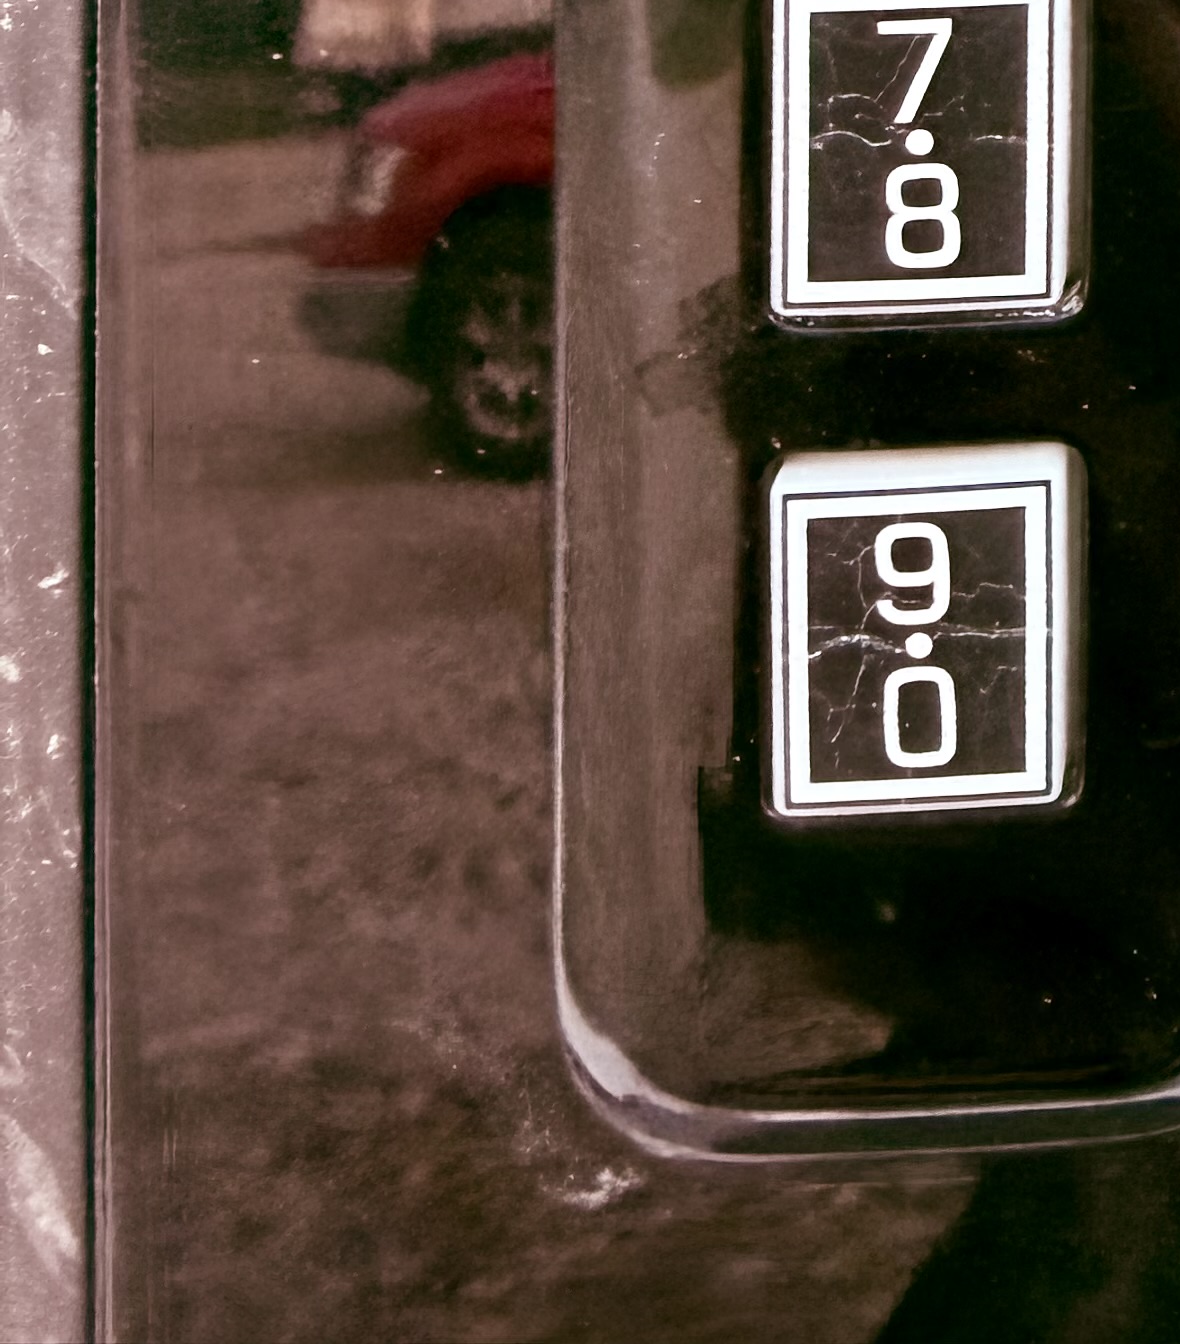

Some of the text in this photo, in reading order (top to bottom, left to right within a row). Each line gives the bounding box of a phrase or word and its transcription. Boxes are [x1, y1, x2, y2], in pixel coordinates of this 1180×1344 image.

[877, 18, 952, 123] 7
[885, 163, 961, 268] 8
[874, 522, 950, 625] 9
[883, 666, 956, 768] 0
